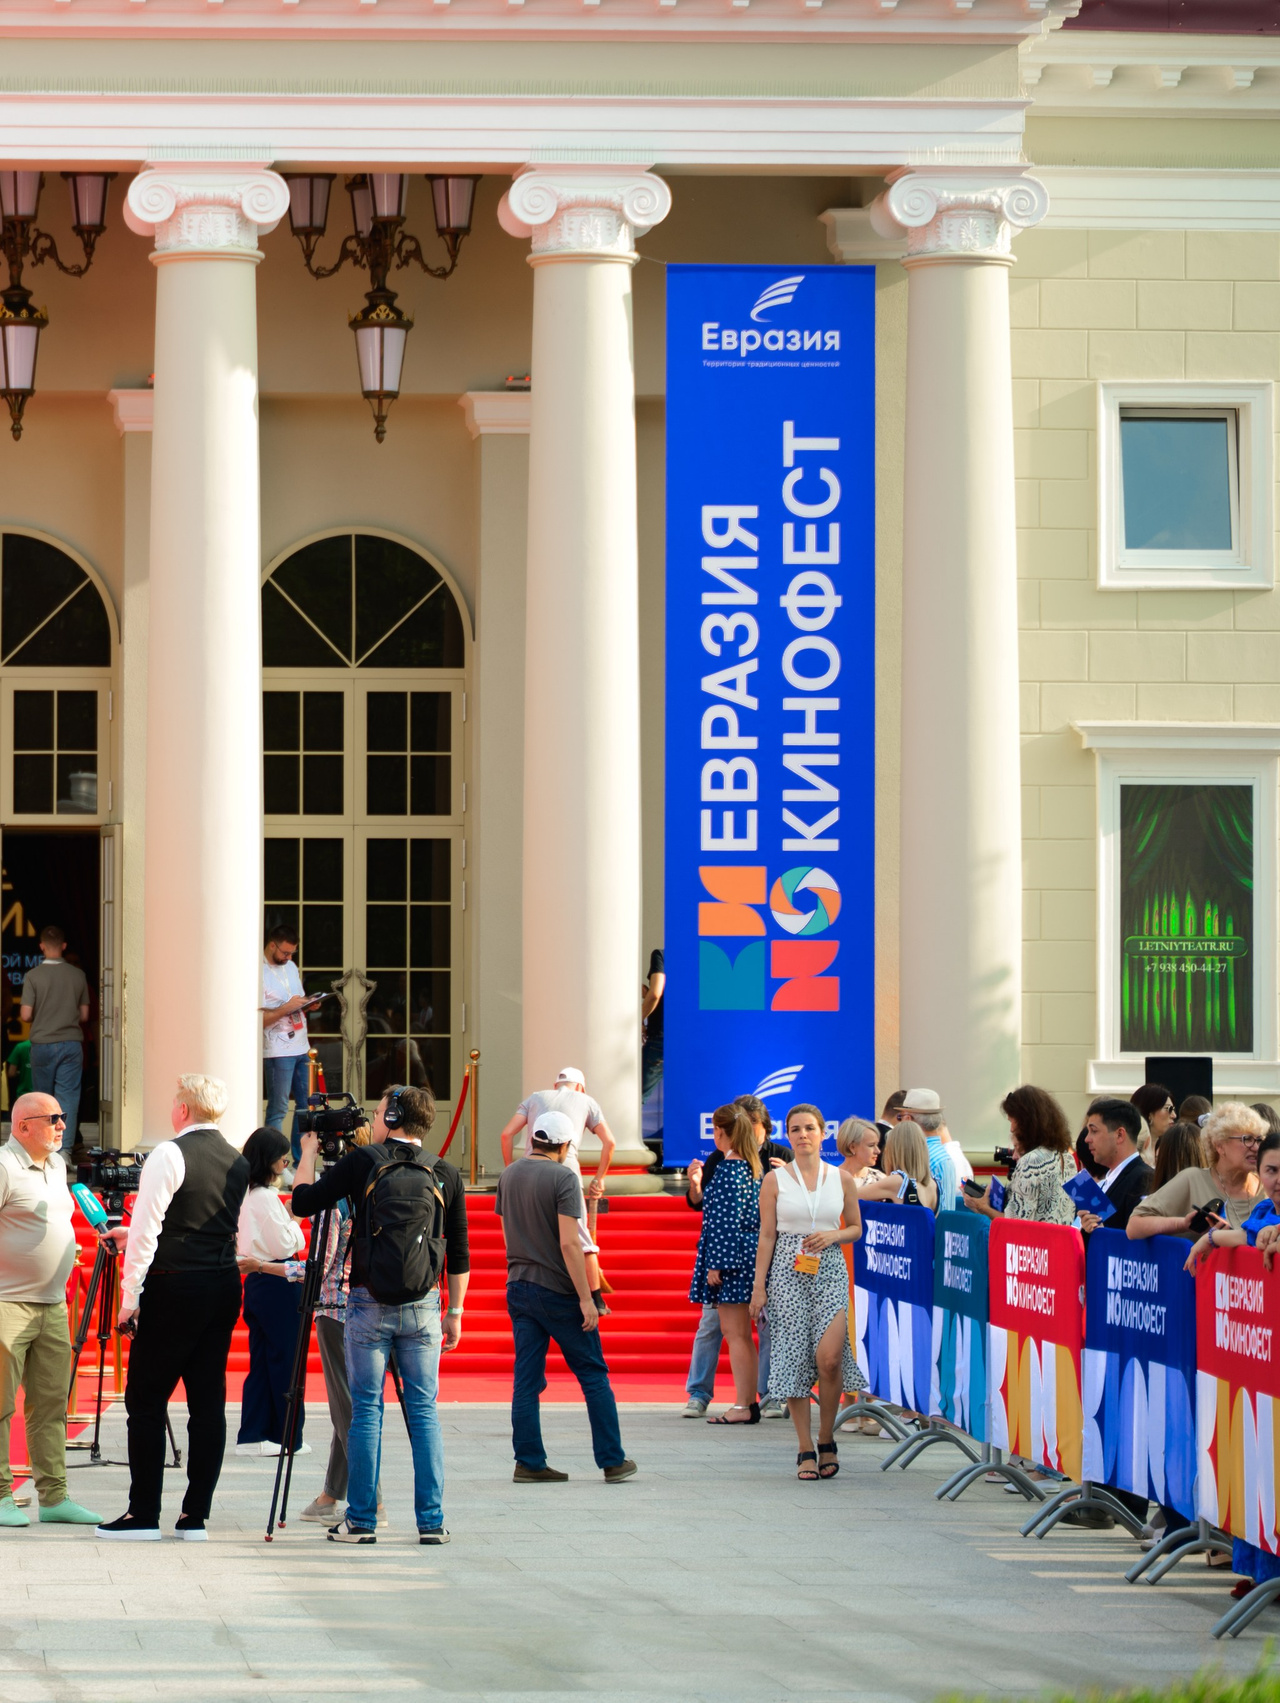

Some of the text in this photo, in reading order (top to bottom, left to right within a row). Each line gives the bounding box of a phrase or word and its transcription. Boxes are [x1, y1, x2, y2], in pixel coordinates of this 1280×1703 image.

[702, 322, 840, 357] Евразия
[703, 360, 745, 368] Территория
[747, 360, 800, 368] традиционных
[780, 420, 843, 852] КИНОФЕСТ
[700, 505, 760, 851] ЕВРАЗИЯ
[1139, 941, 1234, 951] LETNIYTEATR.RU
[1145, 963, 1227, 973] +7 938 450-44-27
[876, 1221, 905, 1247] ЕВРАЗИЯ
[876, 1251, 911, 1280] КИНОФЕСТ
[1019, 1246, 1048, 1276] ЕВРАЗИЯ
[1122, 1260, 1158, 1293] ЕВРАЗИЯ
[1019, 1282, 1055, 1316] КИНОФЕСТ
[1229, 1275, 1264, 1314] ЕВРАЗИЯ
[1121, 1299, 1166, 1335] КИНОФЕСТ
[1229, 1320, 1272, 1362] КИНОФЕСТ
